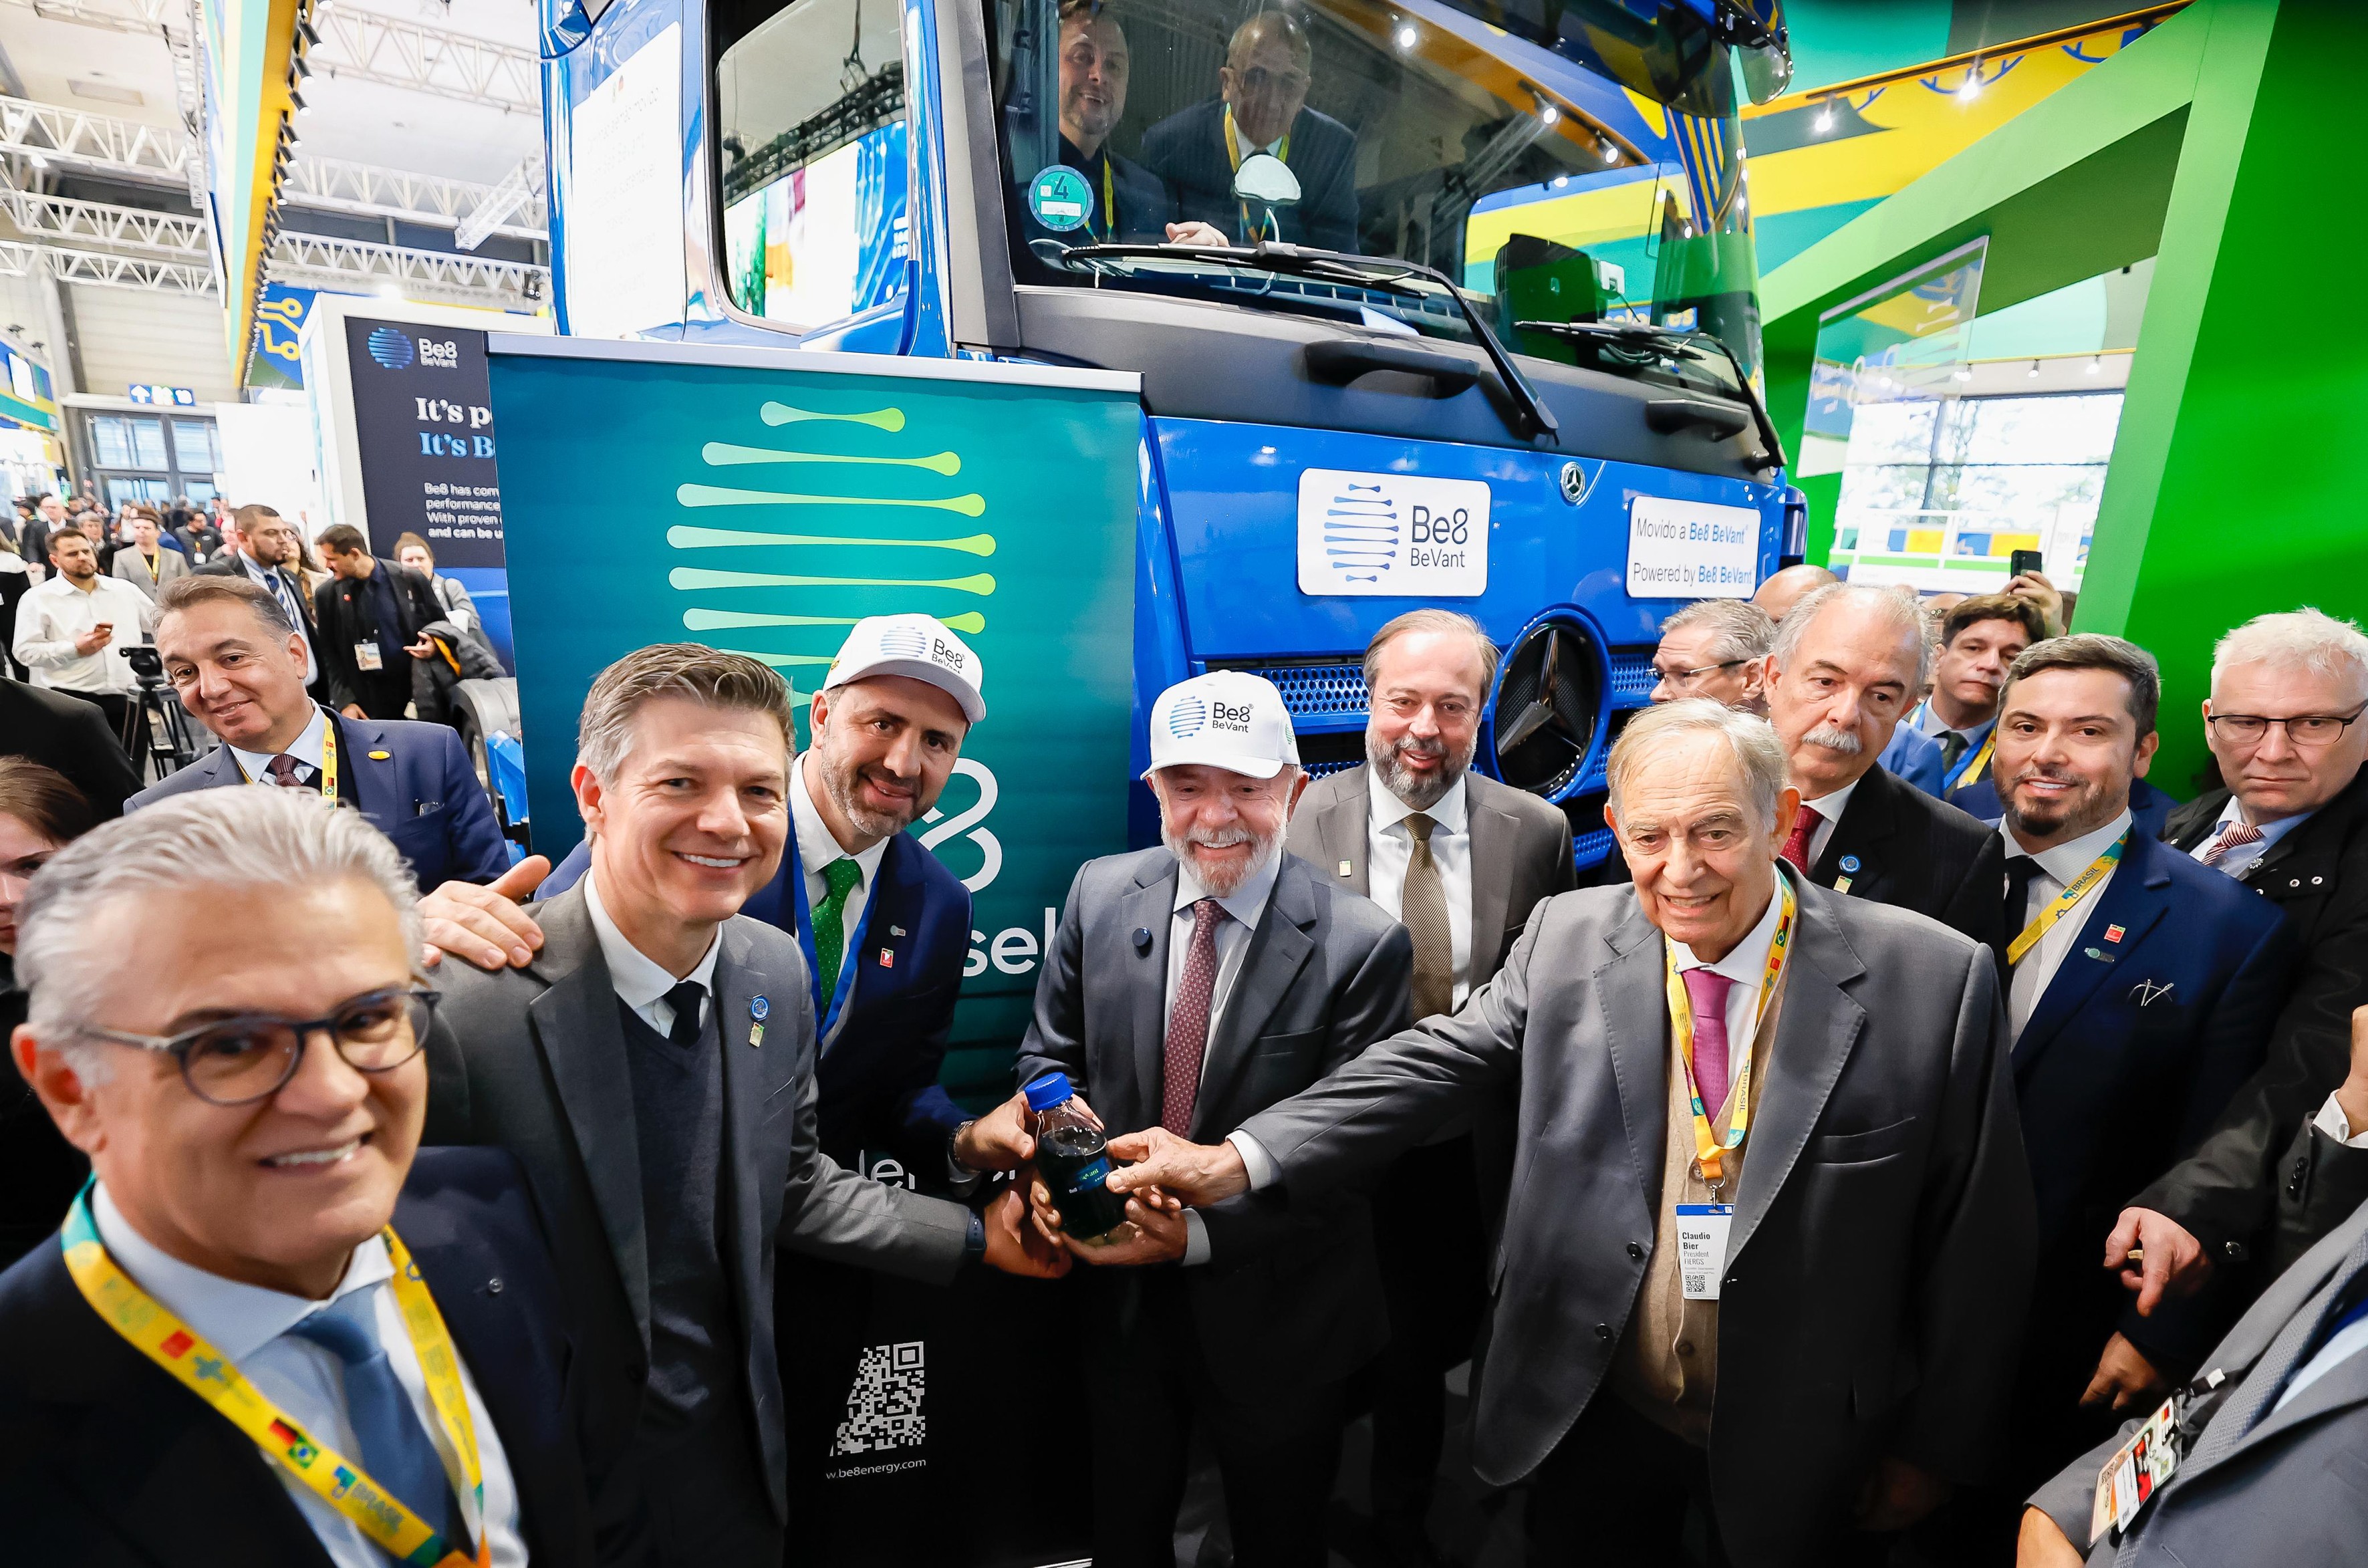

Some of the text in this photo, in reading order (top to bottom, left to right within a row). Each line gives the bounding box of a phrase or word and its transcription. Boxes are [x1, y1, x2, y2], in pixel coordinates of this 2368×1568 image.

[1054, 175, 1069, 199] 4
[418, 338, 458, 359] Be8
[415, 398, 464, 424] It's
[420, 432, 467, 457] It's
[424, 483, 448, 495] Be8
[450, 483, 472, 496] has
[426, 498, 501, 511] performance
[426, 511, 499, 526] With proven
[1412, 505, 1468, 544] Be8
[428, 527, 452, 538] and
[453, 529, 476, 539] can
[477, 527, 493, 539] be
[1637, 518, 1745, 544] Movido a Be8 BeVant
[1411, 548, 1465, 567] BeVant
[1633, 563, 1752, 587] Powered by Be8 BeVant
[934, 638, 962, 668] Be8
[1212, 721, 1248, 733] BeVant
[2071, 868, 2100, 891] BRASIL
[1739, 1075, 1748, 1114] BRASIL
[1682, 1232, 1710, 1240] Claudio
